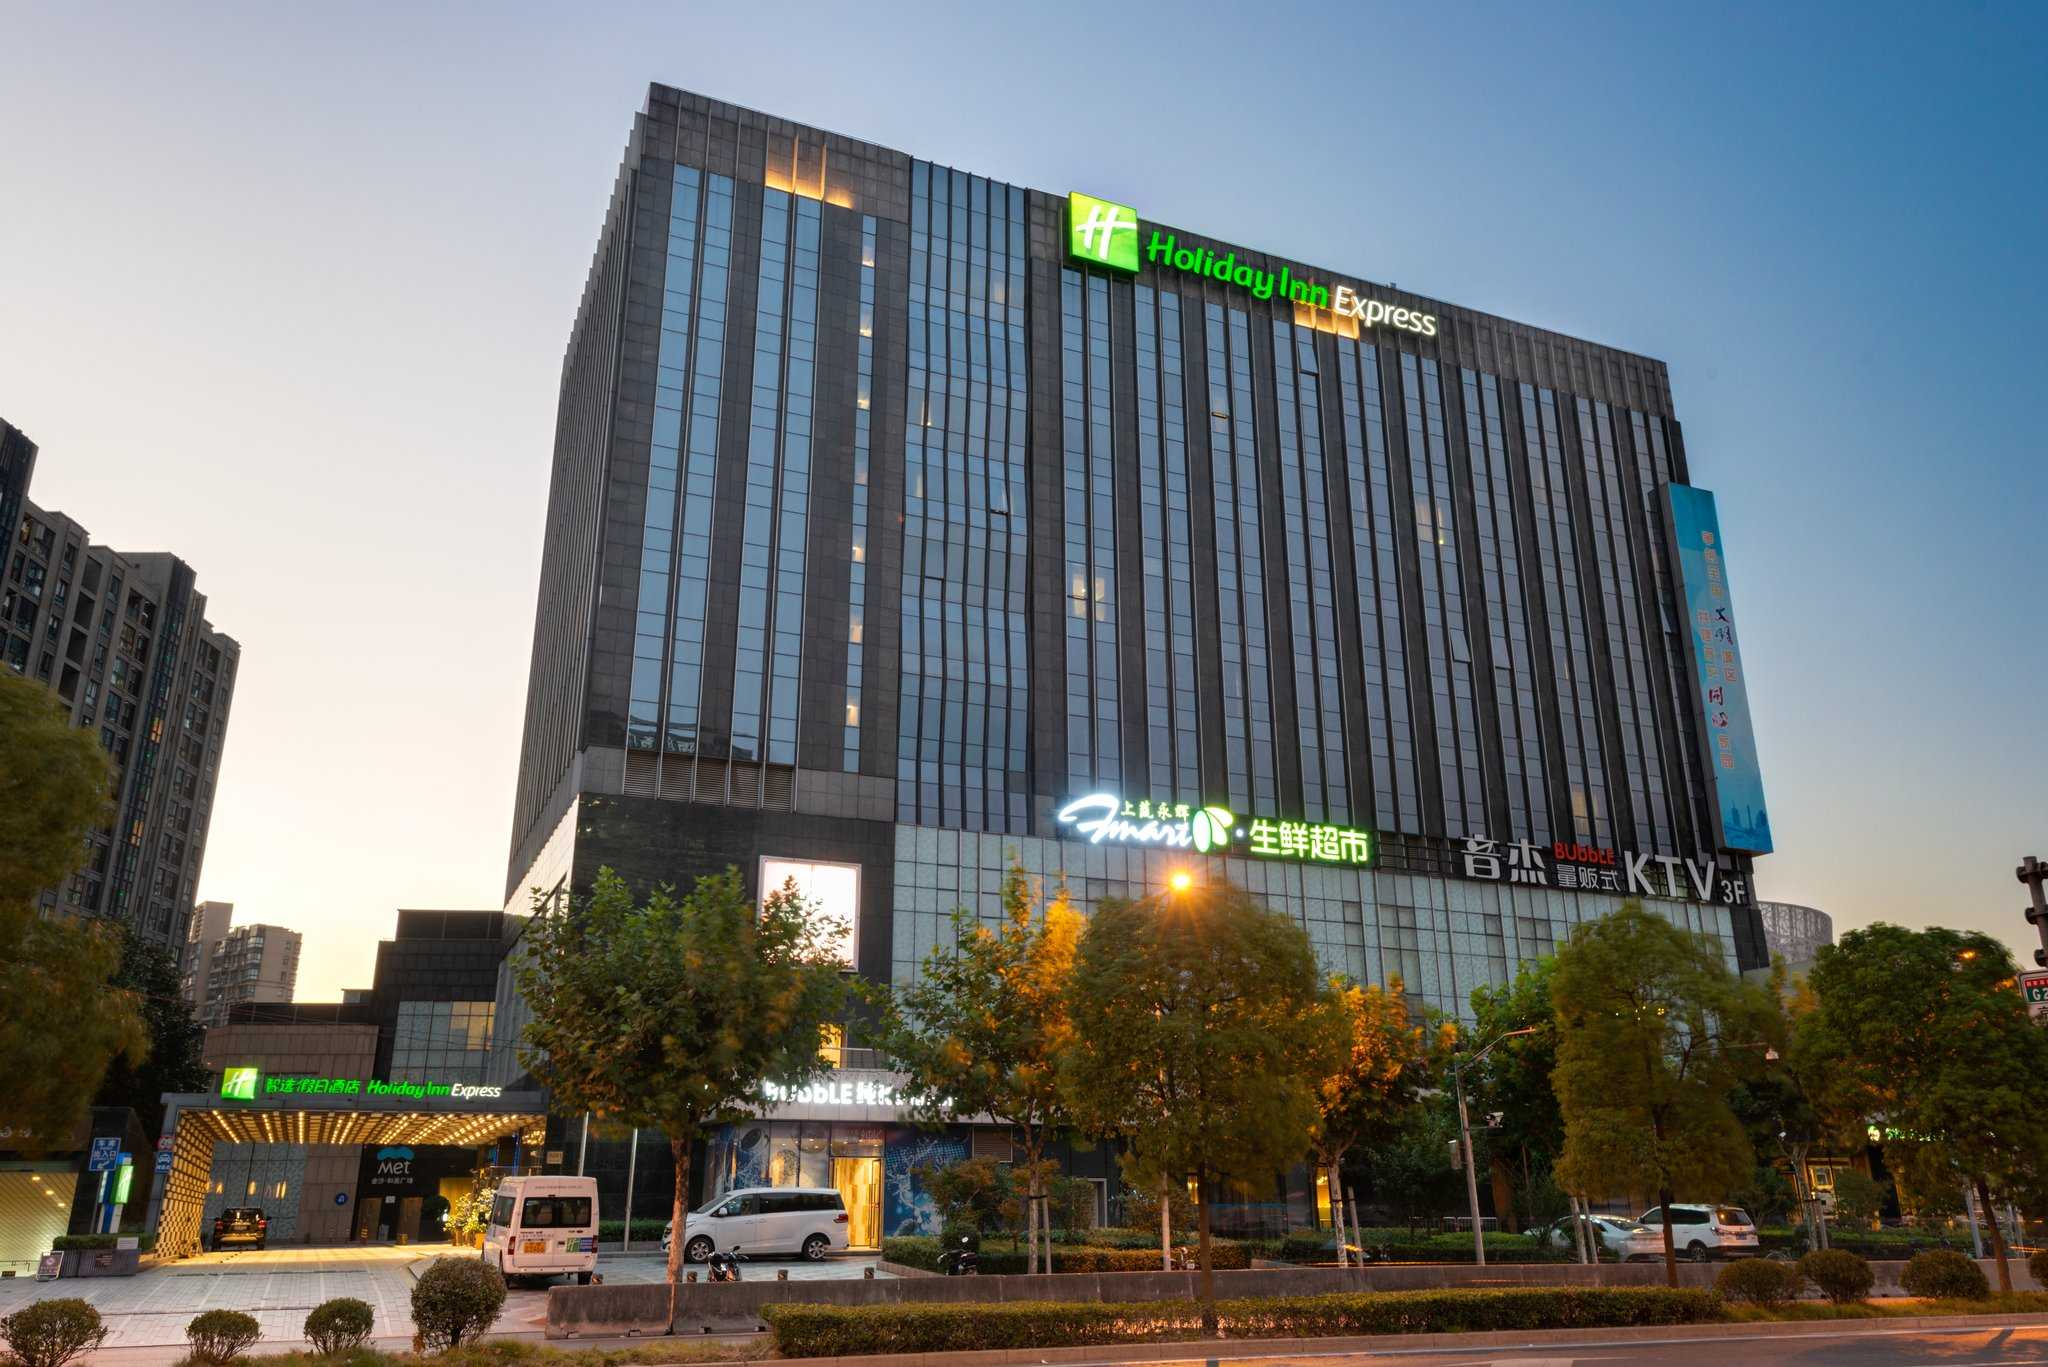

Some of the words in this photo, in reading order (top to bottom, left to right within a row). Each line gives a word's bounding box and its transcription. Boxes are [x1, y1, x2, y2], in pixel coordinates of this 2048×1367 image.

[1146, 231, 1276, 300] Holiday
[1279, 266, 1329, 309] Inn
[1334, 286, 1437, 337] Express
[1248, 819, 1369, 864] 生鲜超市
[1556, 863, 1621, 892] 量贩式
[1624, 850, 1716, 902] KTV
[1721, 879, 1747, 905] 3F
[265, 1076, 361, 1095] 智选假日酒店
[367, 1080, 424, 1099] Holiday
[427, 1081, 449, 1096] Inn
[450, 1083, 502, 1099] Express
